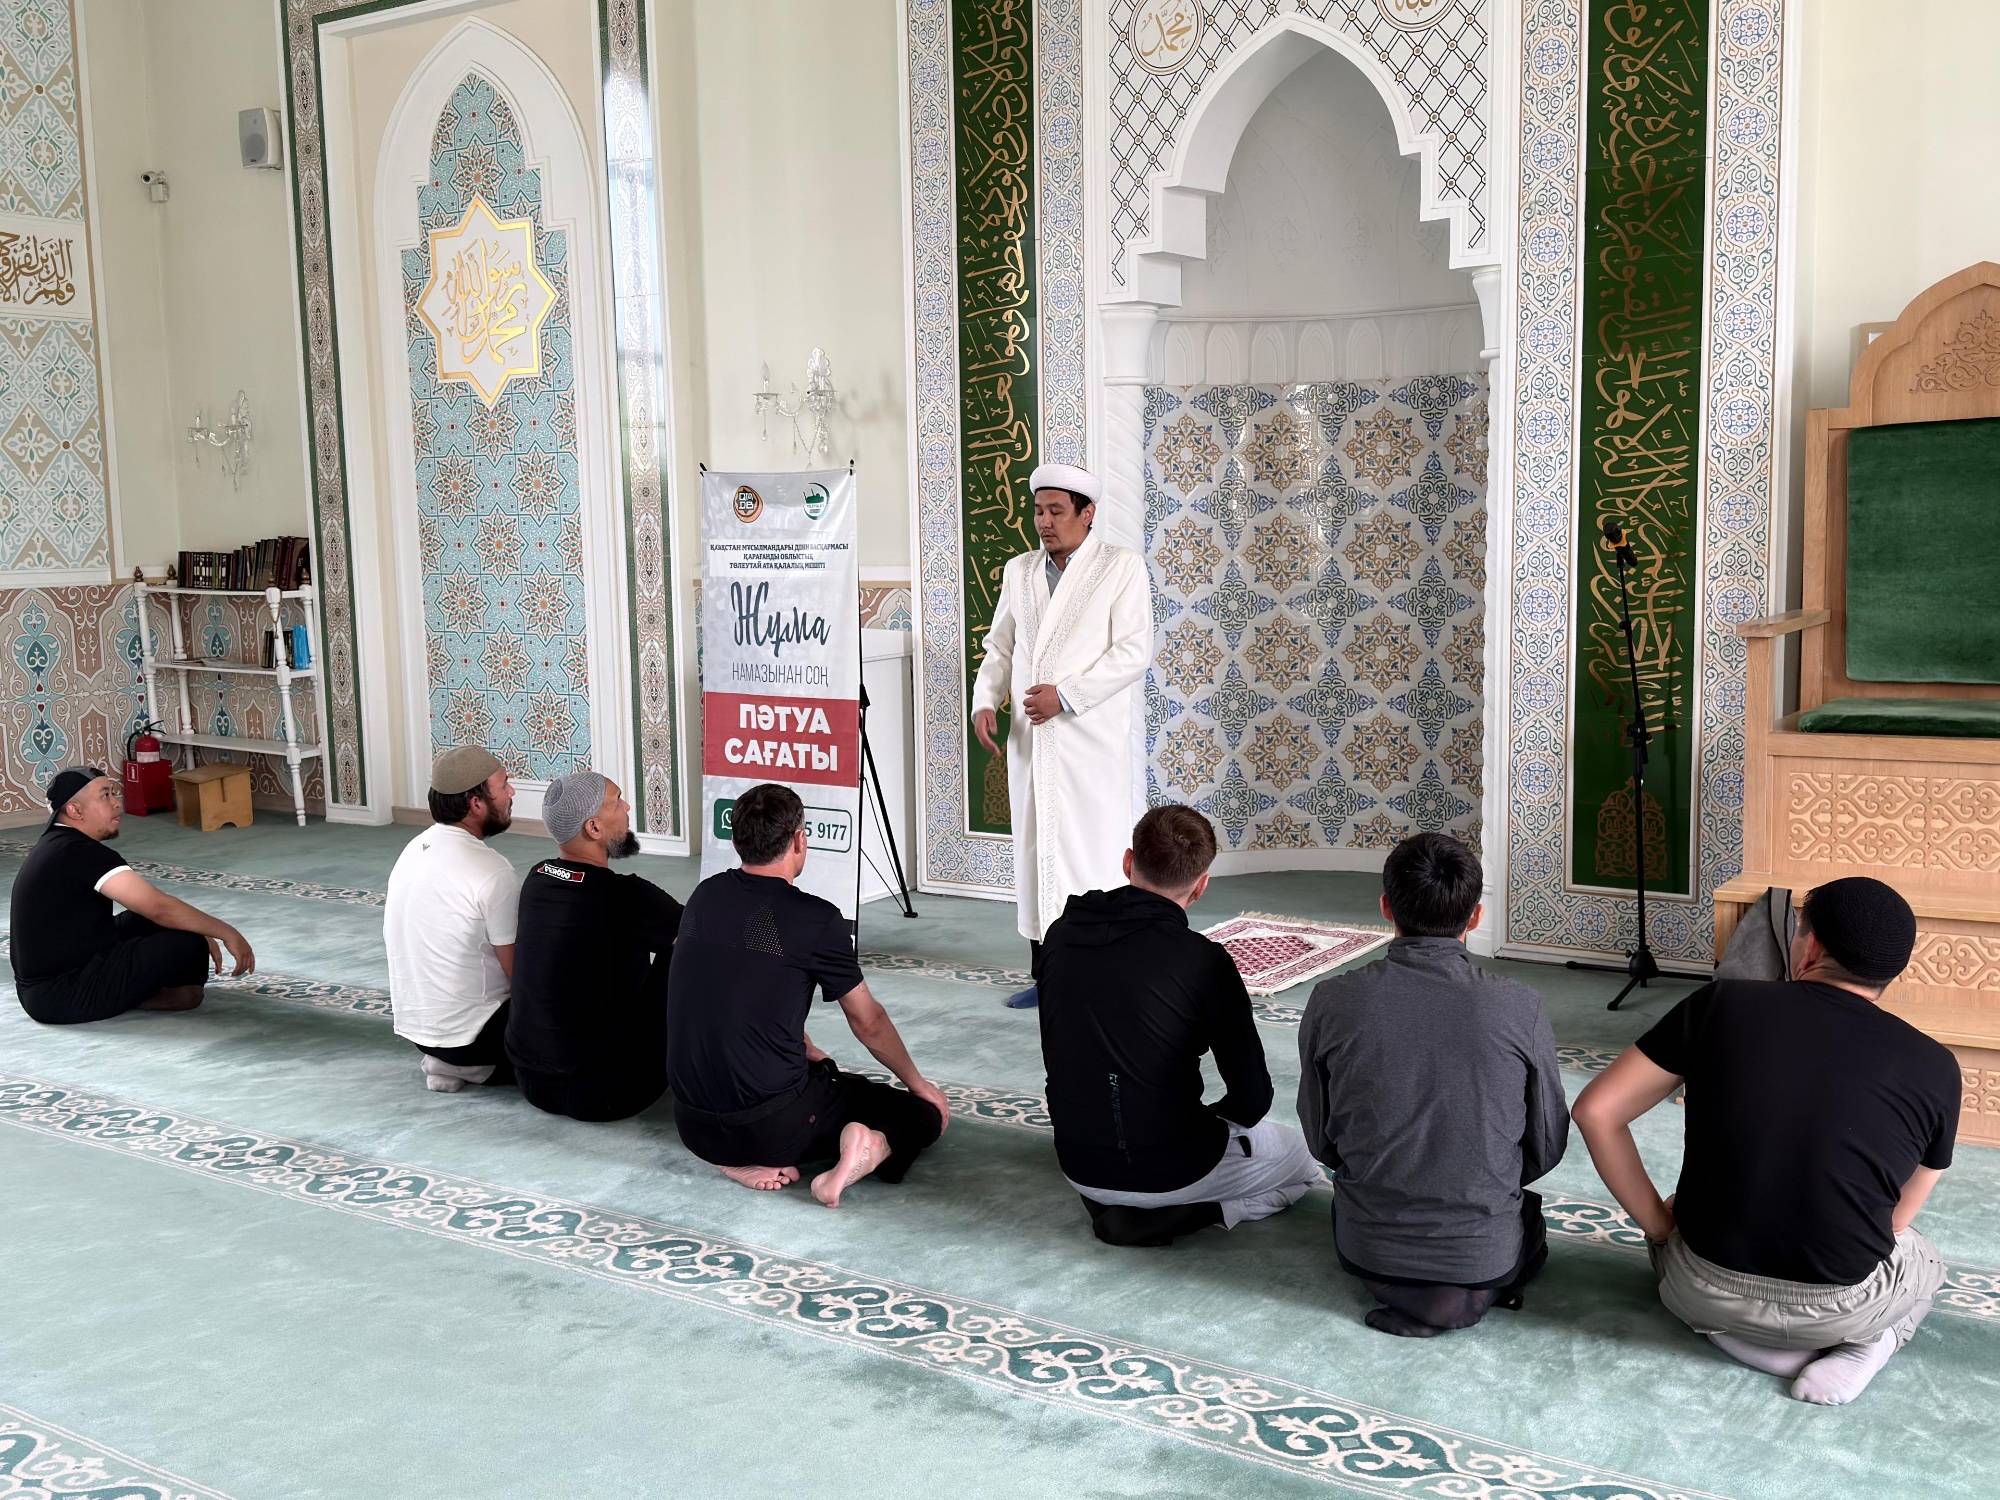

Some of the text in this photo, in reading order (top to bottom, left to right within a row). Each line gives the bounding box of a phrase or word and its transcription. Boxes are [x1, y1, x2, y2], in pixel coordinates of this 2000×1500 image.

[730, 581, 832, 658] Жұма
[732, 661, 829, 687] НАМАЗЫНАН СОҢ
[739, 703, 832, 735] ПӘТУА
[724, 737, 838, 772] САҒАТЫ
[818, 822, 848, 841] 9177
